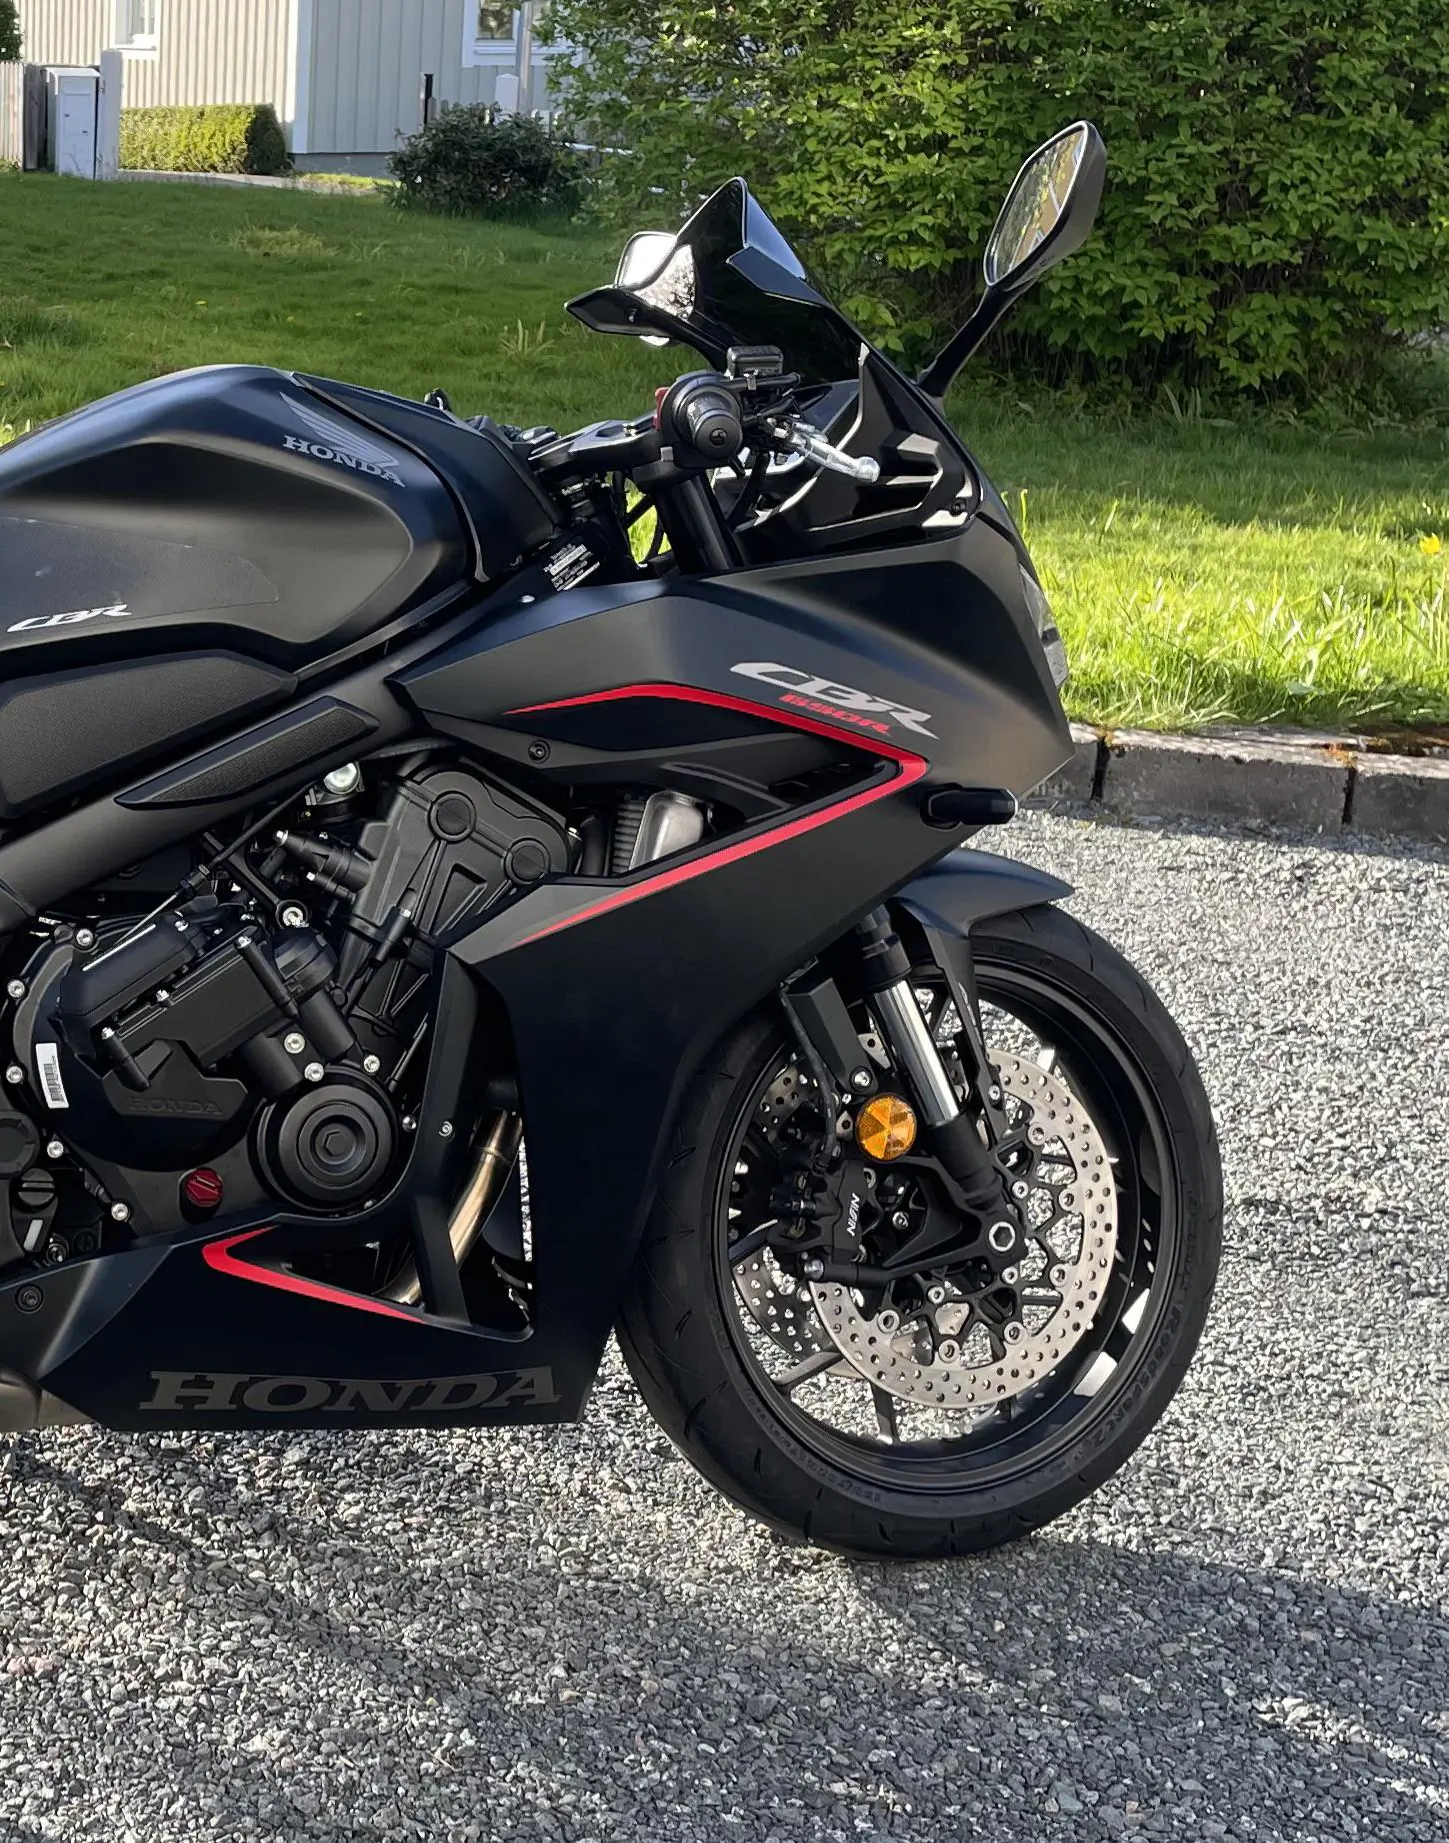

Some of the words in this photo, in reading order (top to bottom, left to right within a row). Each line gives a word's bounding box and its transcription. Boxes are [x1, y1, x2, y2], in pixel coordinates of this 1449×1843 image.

[283, 435, 405, 487] HONDA
[7, 604, 132, 632] CBR
[729, 662, 940, 740] CBR
[126, 1096, 224, 1116] HONDA
[138, 1366, 562, 1411] HONDA
